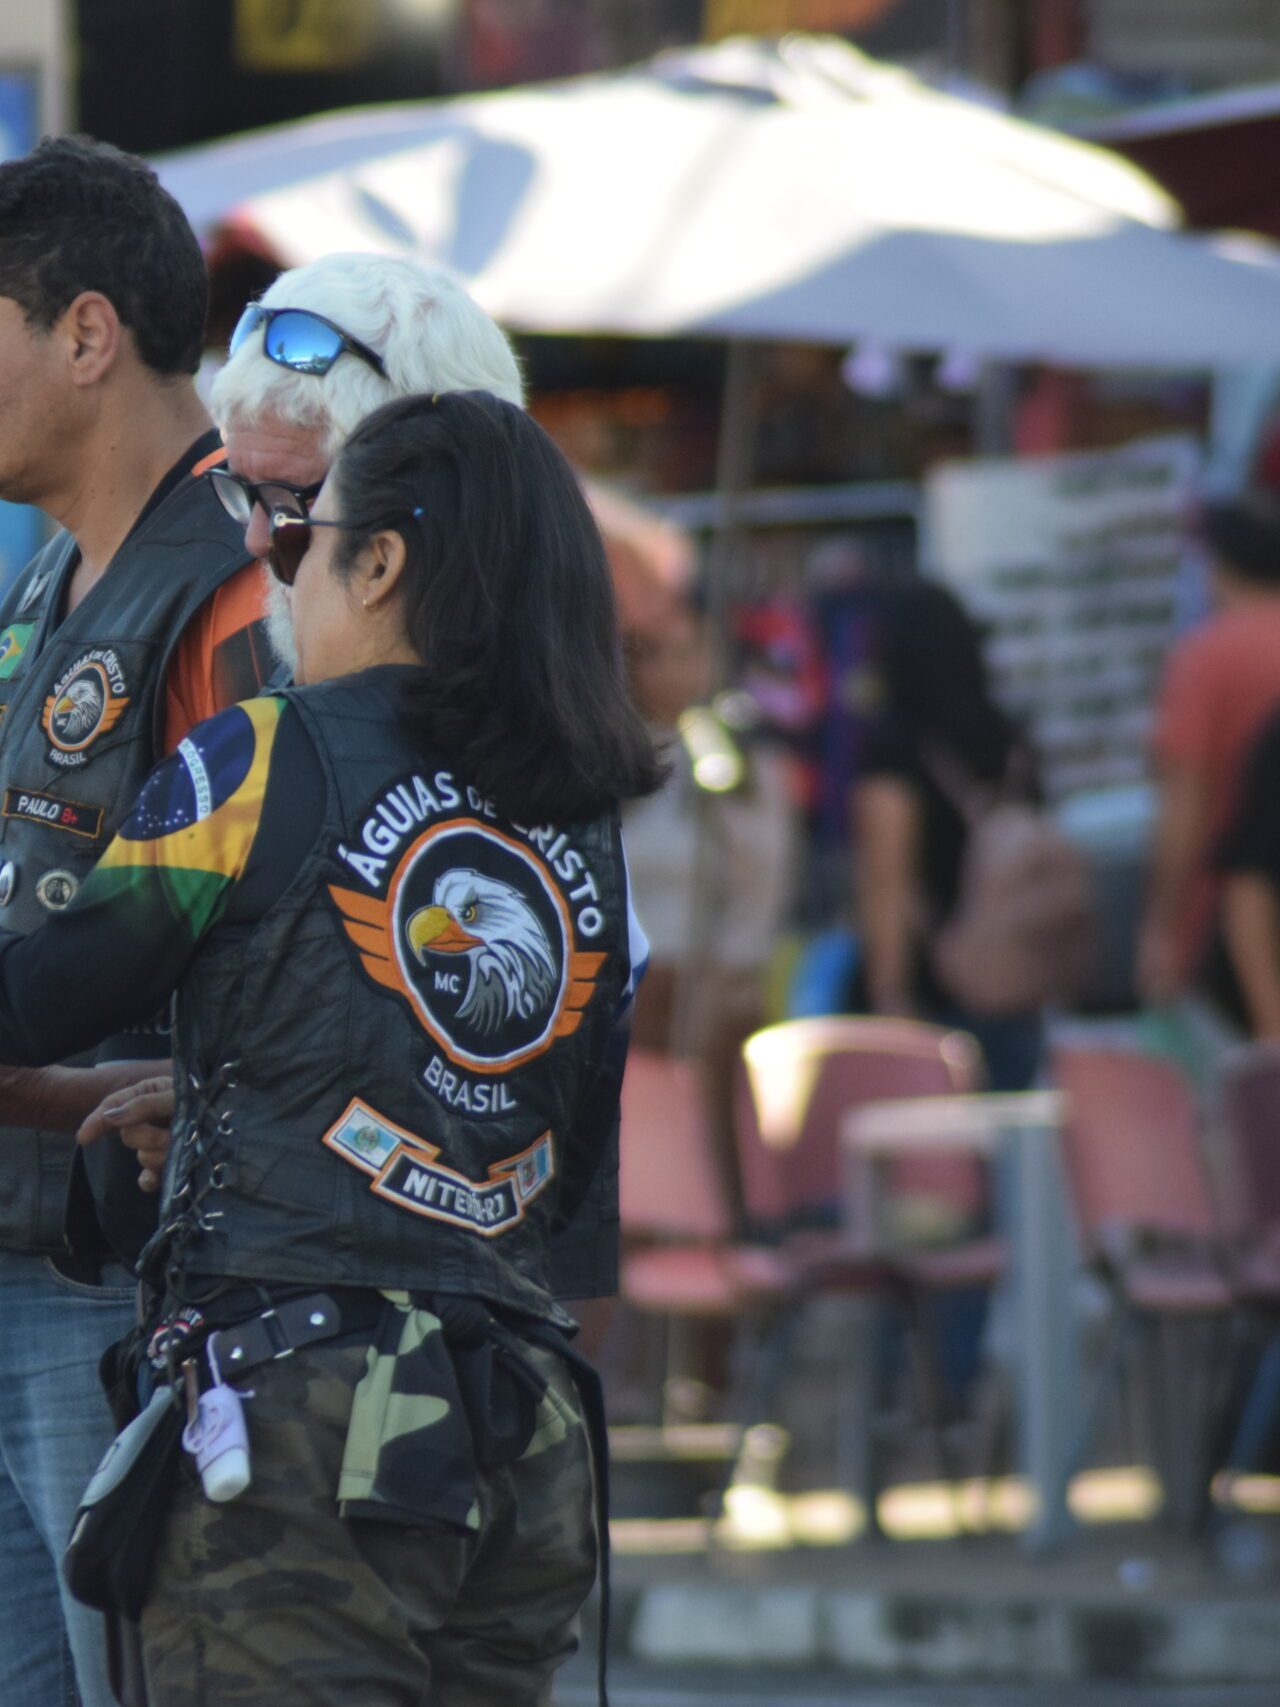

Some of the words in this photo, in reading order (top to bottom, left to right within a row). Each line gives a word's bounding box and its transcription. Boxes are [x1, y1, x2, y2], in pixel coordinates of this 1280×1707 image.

[49, 748, 87, 765] BRASIL
[17, 795, 60, 819] PAULO
[337, 771, 461, 888] ÁGUIAS
[510, 820, 603, 938] RISTO
[434, 971, 461, 996] MC
[423, 1055, 517, 1113] BRASIL
